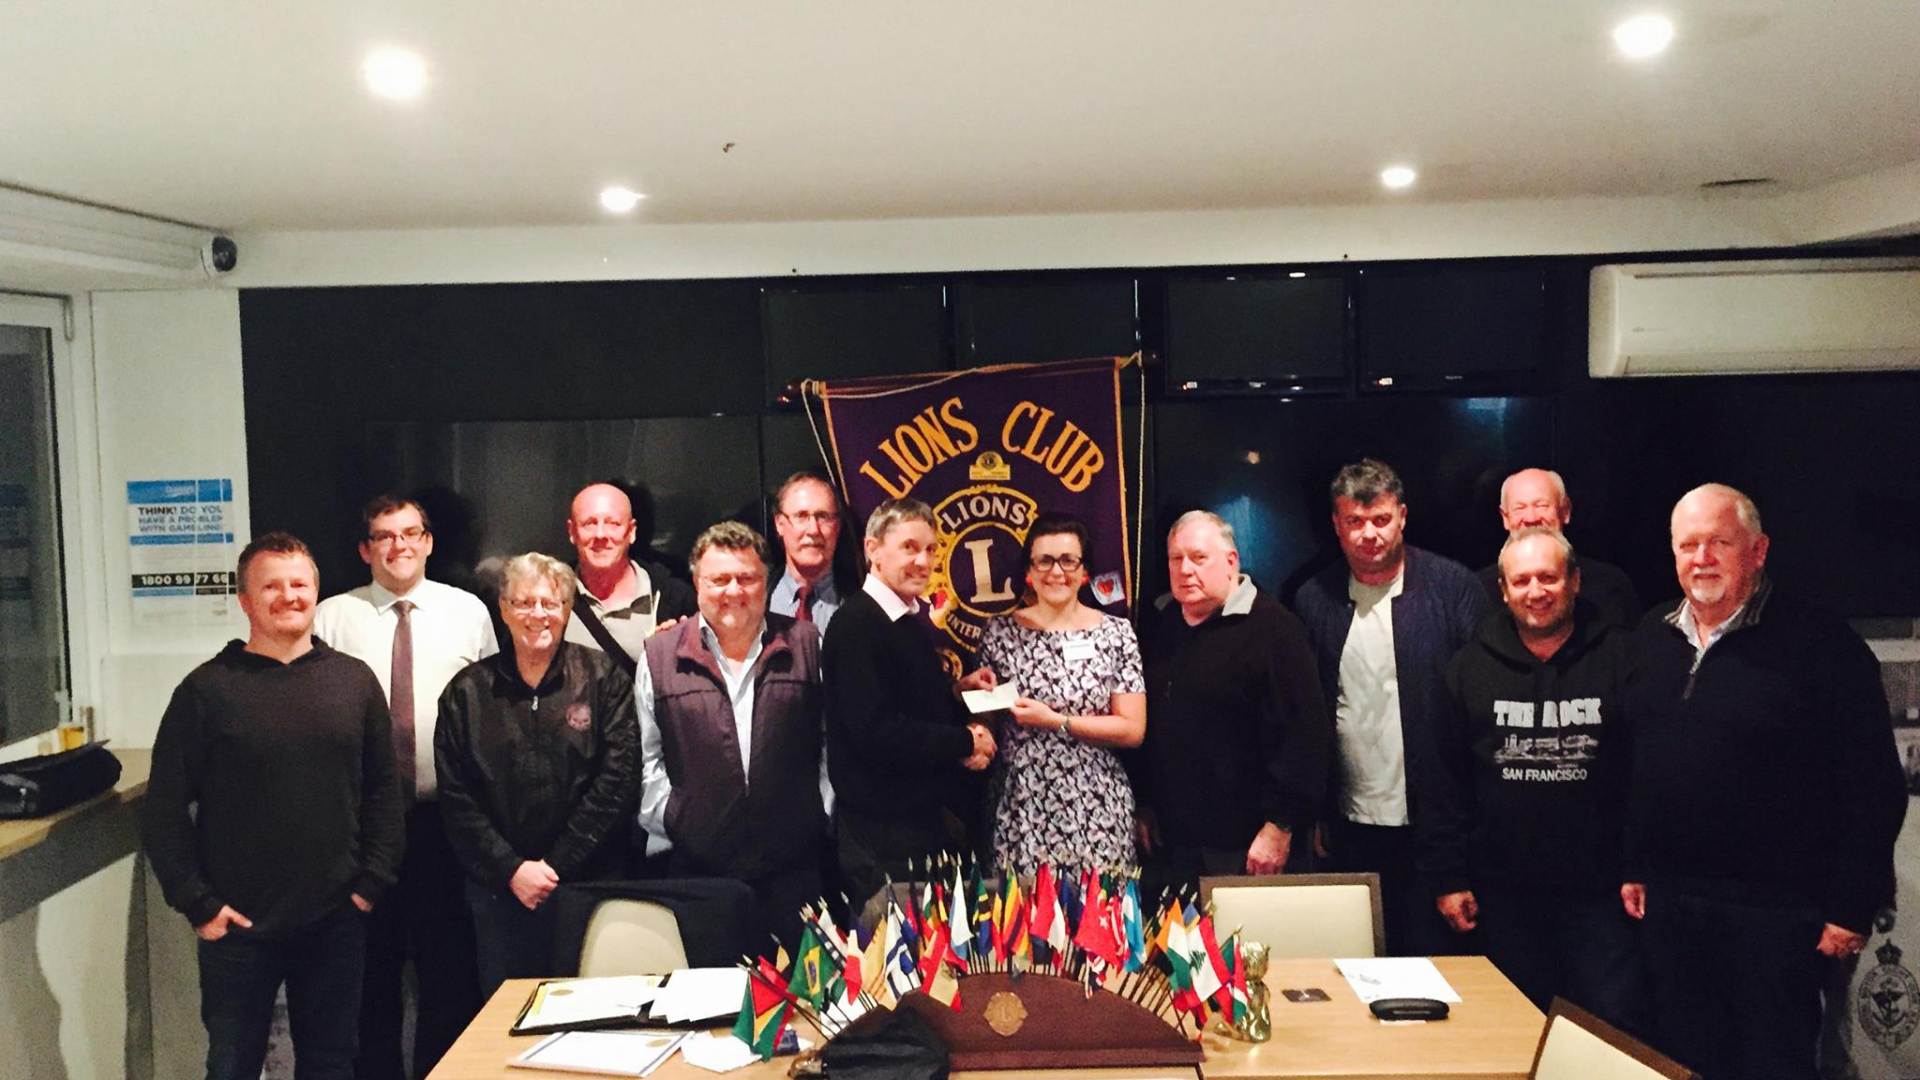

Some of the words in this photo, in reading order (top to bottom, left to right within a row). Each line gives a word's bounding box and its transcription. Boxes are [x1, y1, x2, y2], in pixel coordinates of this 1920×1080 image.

[860, 397, 979, 499] LIONS
[1001, 400, 1105, 492] CLUB
[138, 506, 177, 515] THINK!
[941, 495, 1028, 530] LIONS
[141, 575, 172, 586] 1800
[175, 574, 191, 585] 99
[964, 538, 1016, 603] L
[1493, 700, 1535, 727] THE
[1542, 698, 1602, 728] ROCK
[1501, 766, 1523, 780] SAN
[1525, 768, 1588, 782] FRANCISCO
